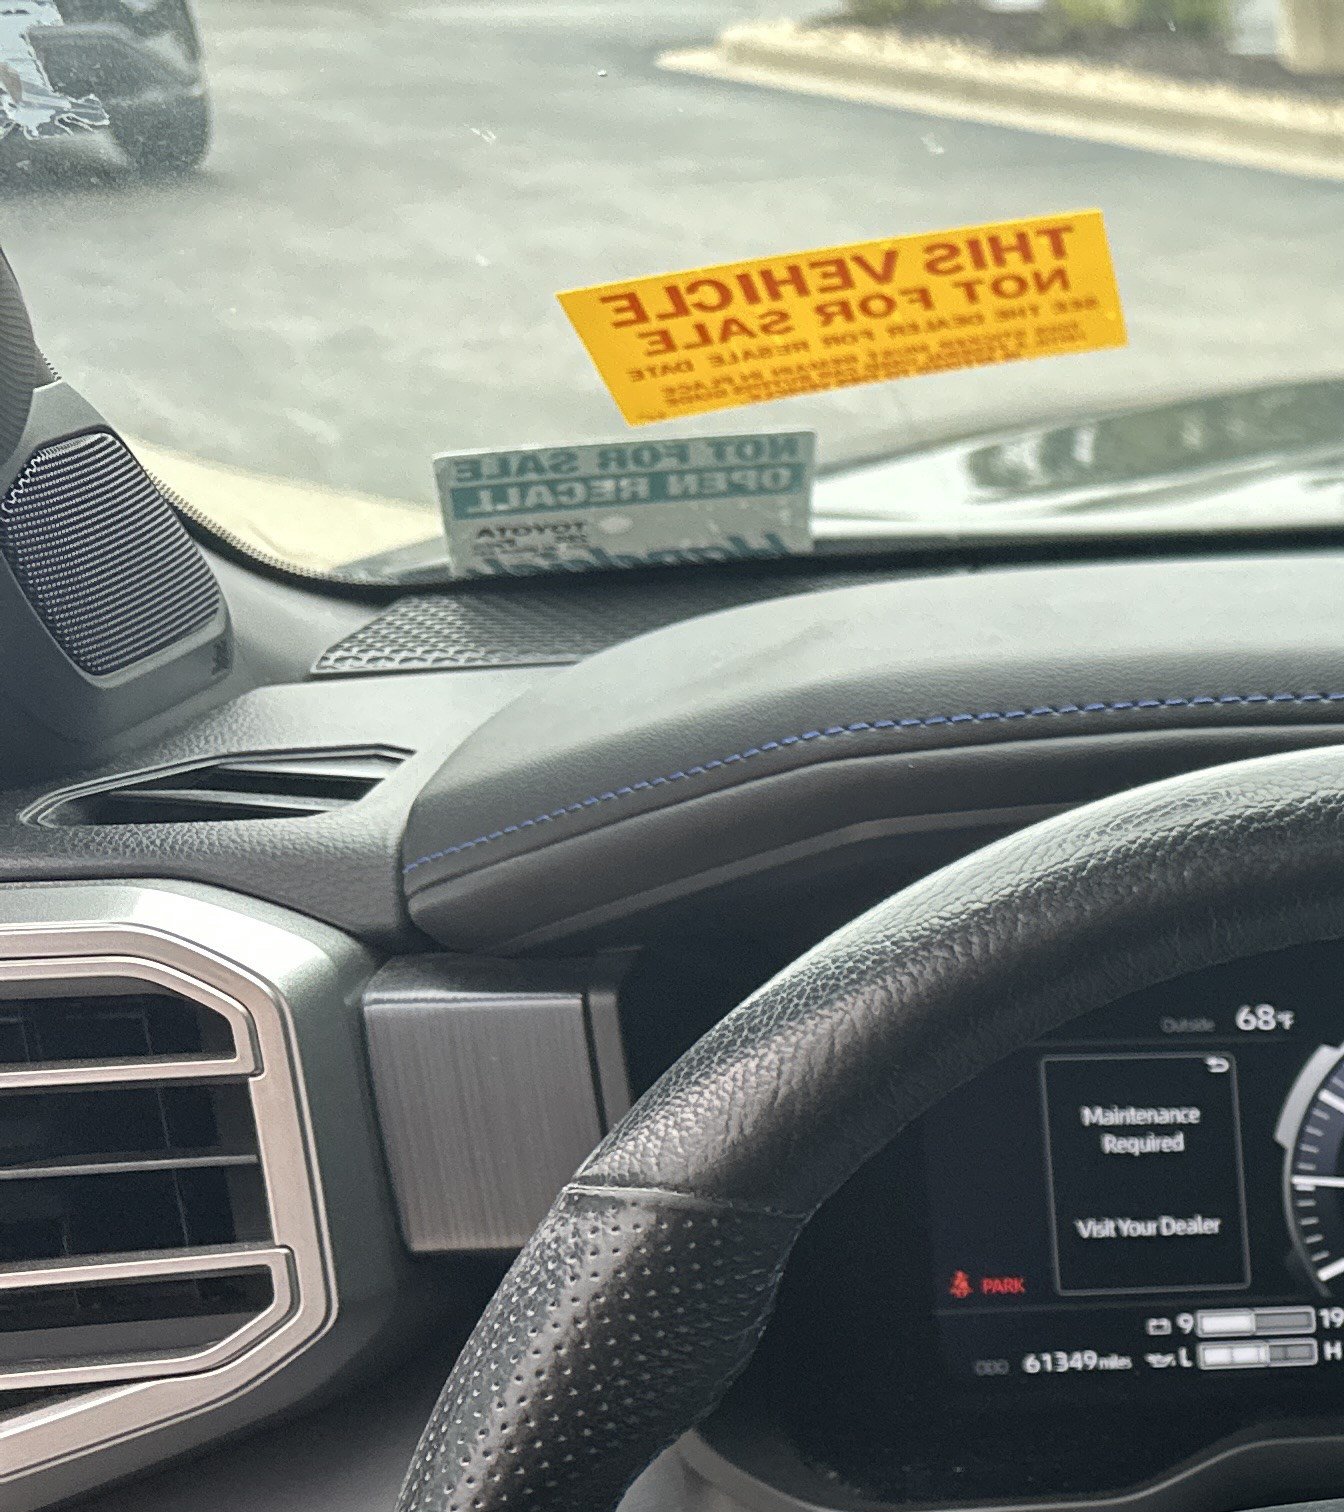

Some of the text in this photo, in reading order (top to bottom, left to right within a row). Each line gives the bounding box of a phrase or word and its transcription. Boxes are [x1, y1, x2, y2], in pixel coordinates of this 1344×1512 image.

[1080, 1103, 1200, 1127] Maintenance
[1101, 1131, 1185, 1158] Required
[1076, 1215, 1221, 1239] Visit Your Dealer
[981, 1276, 1025, 1294] PARK
[1177, 1313, 1194, 1334] 9
[1022, 1350, 1097, 1374] 61349
[1179, 1347, 1192, 1367] L
[1324, 1341, 1342, 1361] H
